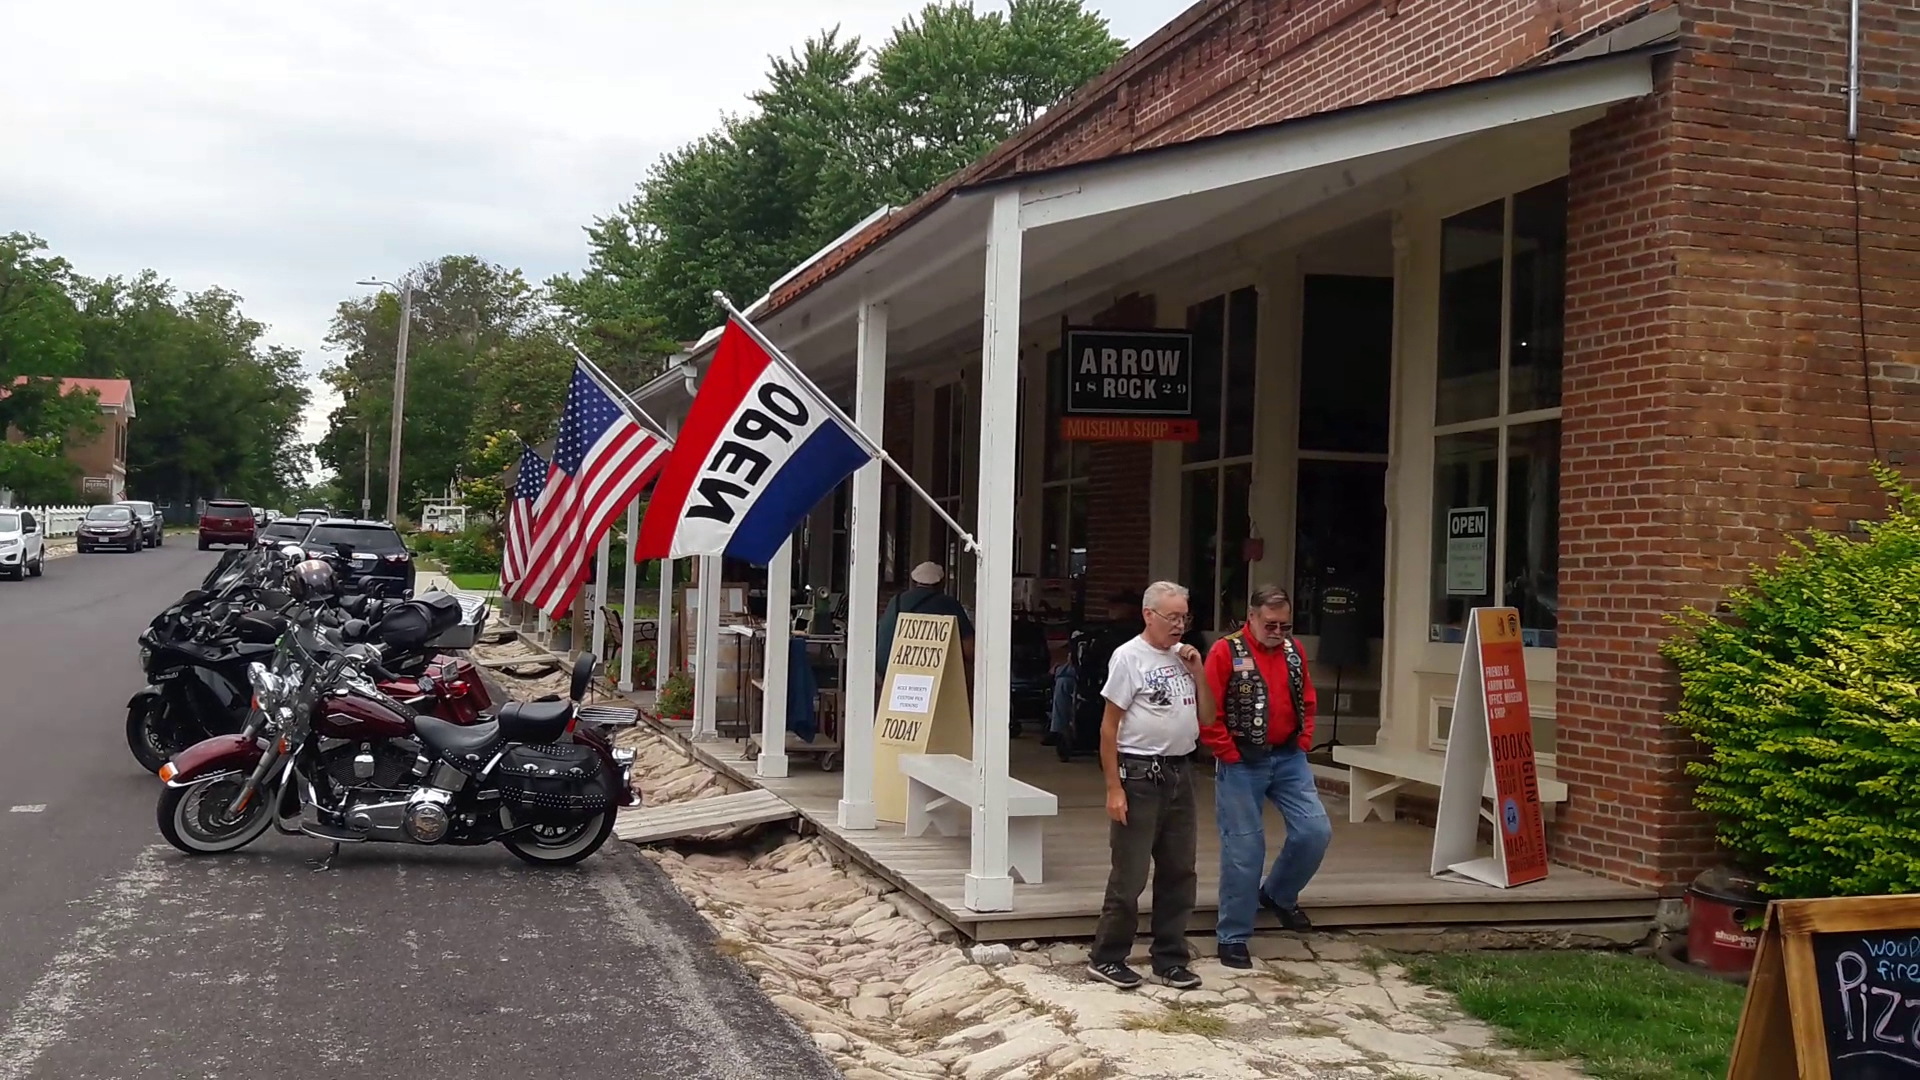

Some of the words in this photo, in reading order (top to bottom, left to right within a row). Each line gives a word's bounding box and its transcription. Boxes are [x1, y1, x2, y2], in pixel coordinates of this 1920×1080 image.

[1080, 347, 1181, 376] ARROW
[1103, 378, 1157, 399] ROCK
[1067, 420, 1129, 437] MUSEUM
[1133, 421, 1169, 438] SHOP
[1451, 515, 1484, 534] OPEN
[897, 618, 950, 642] VISITING
[892, 644, 943, 668] ARTISTS
[881, 718, 922, 742] TODAY
[1493, 731, 1533, 762] BOOKS
[1522, 761, 1537, 803] GUN
